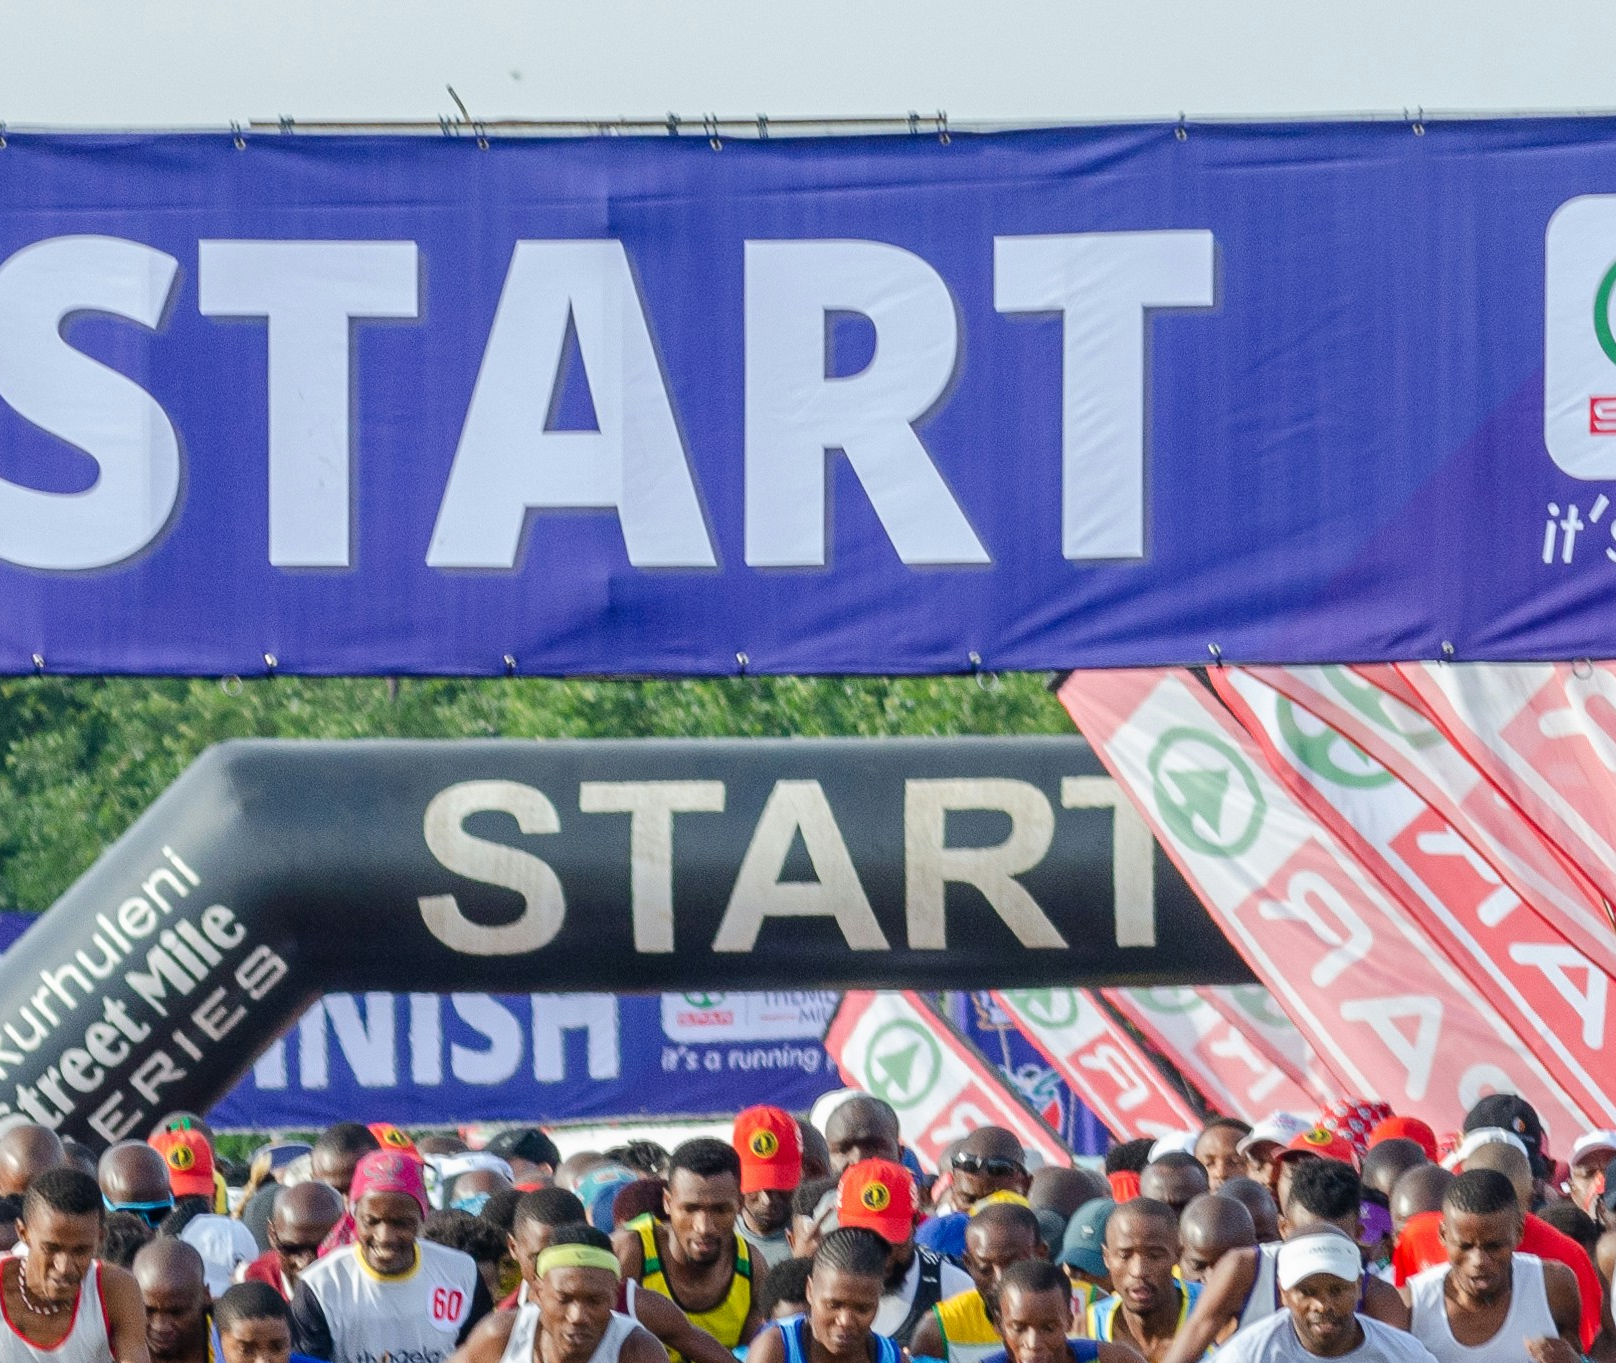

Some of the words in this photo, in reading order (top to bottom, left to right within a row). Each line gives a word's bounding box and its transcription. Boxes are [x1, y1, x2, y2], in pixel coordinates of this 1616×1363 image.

[417, 778, 1155, 958] START
[124, 903, 248, 1018] Mile
[60, 944, 289, 1145] ERIES
[433, 1287, 462, 1322] 60
